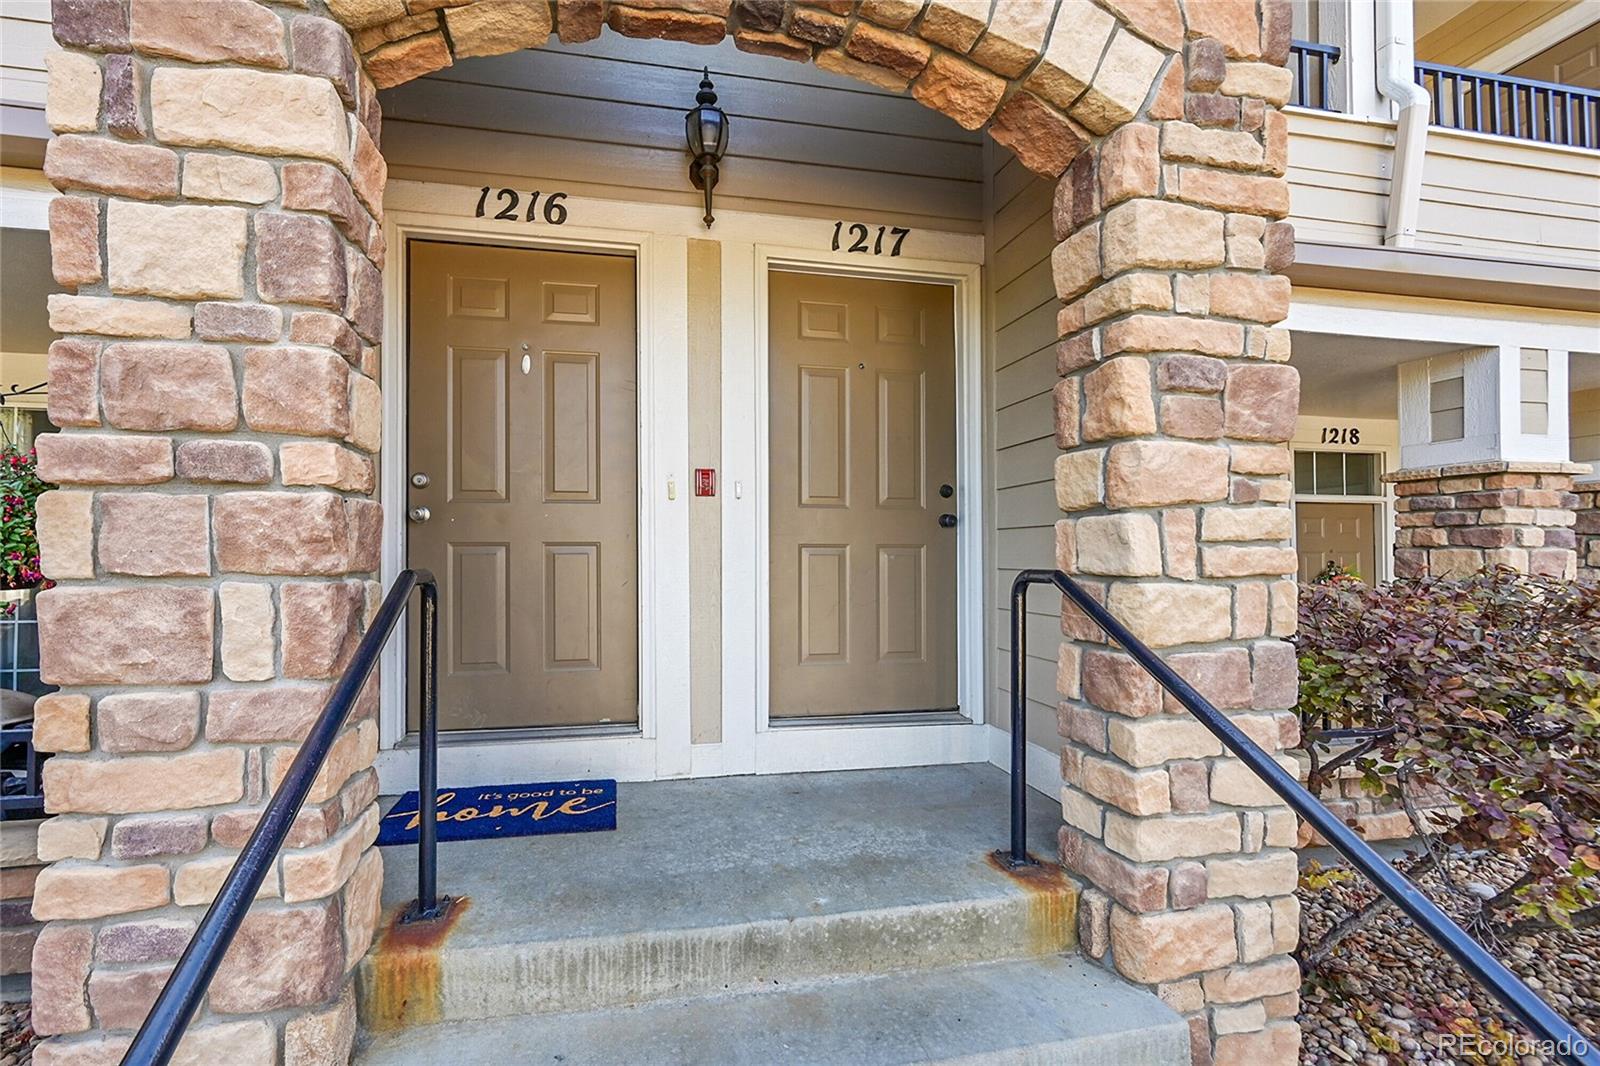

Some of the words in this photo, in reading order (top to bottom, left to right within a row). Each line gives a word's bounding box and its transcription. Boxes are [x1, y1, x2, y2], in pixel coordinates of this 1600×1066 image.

[475, 186, 568, 225] 1216
[831, 221, 911, 257] 1217
[1320, 427, 1360, 445] 1218
[478, 792, 503, 801] It's
[507, 789, 555, 802] good
[560, 788, 577, 796] to
[581, 787, 604, 795] be
